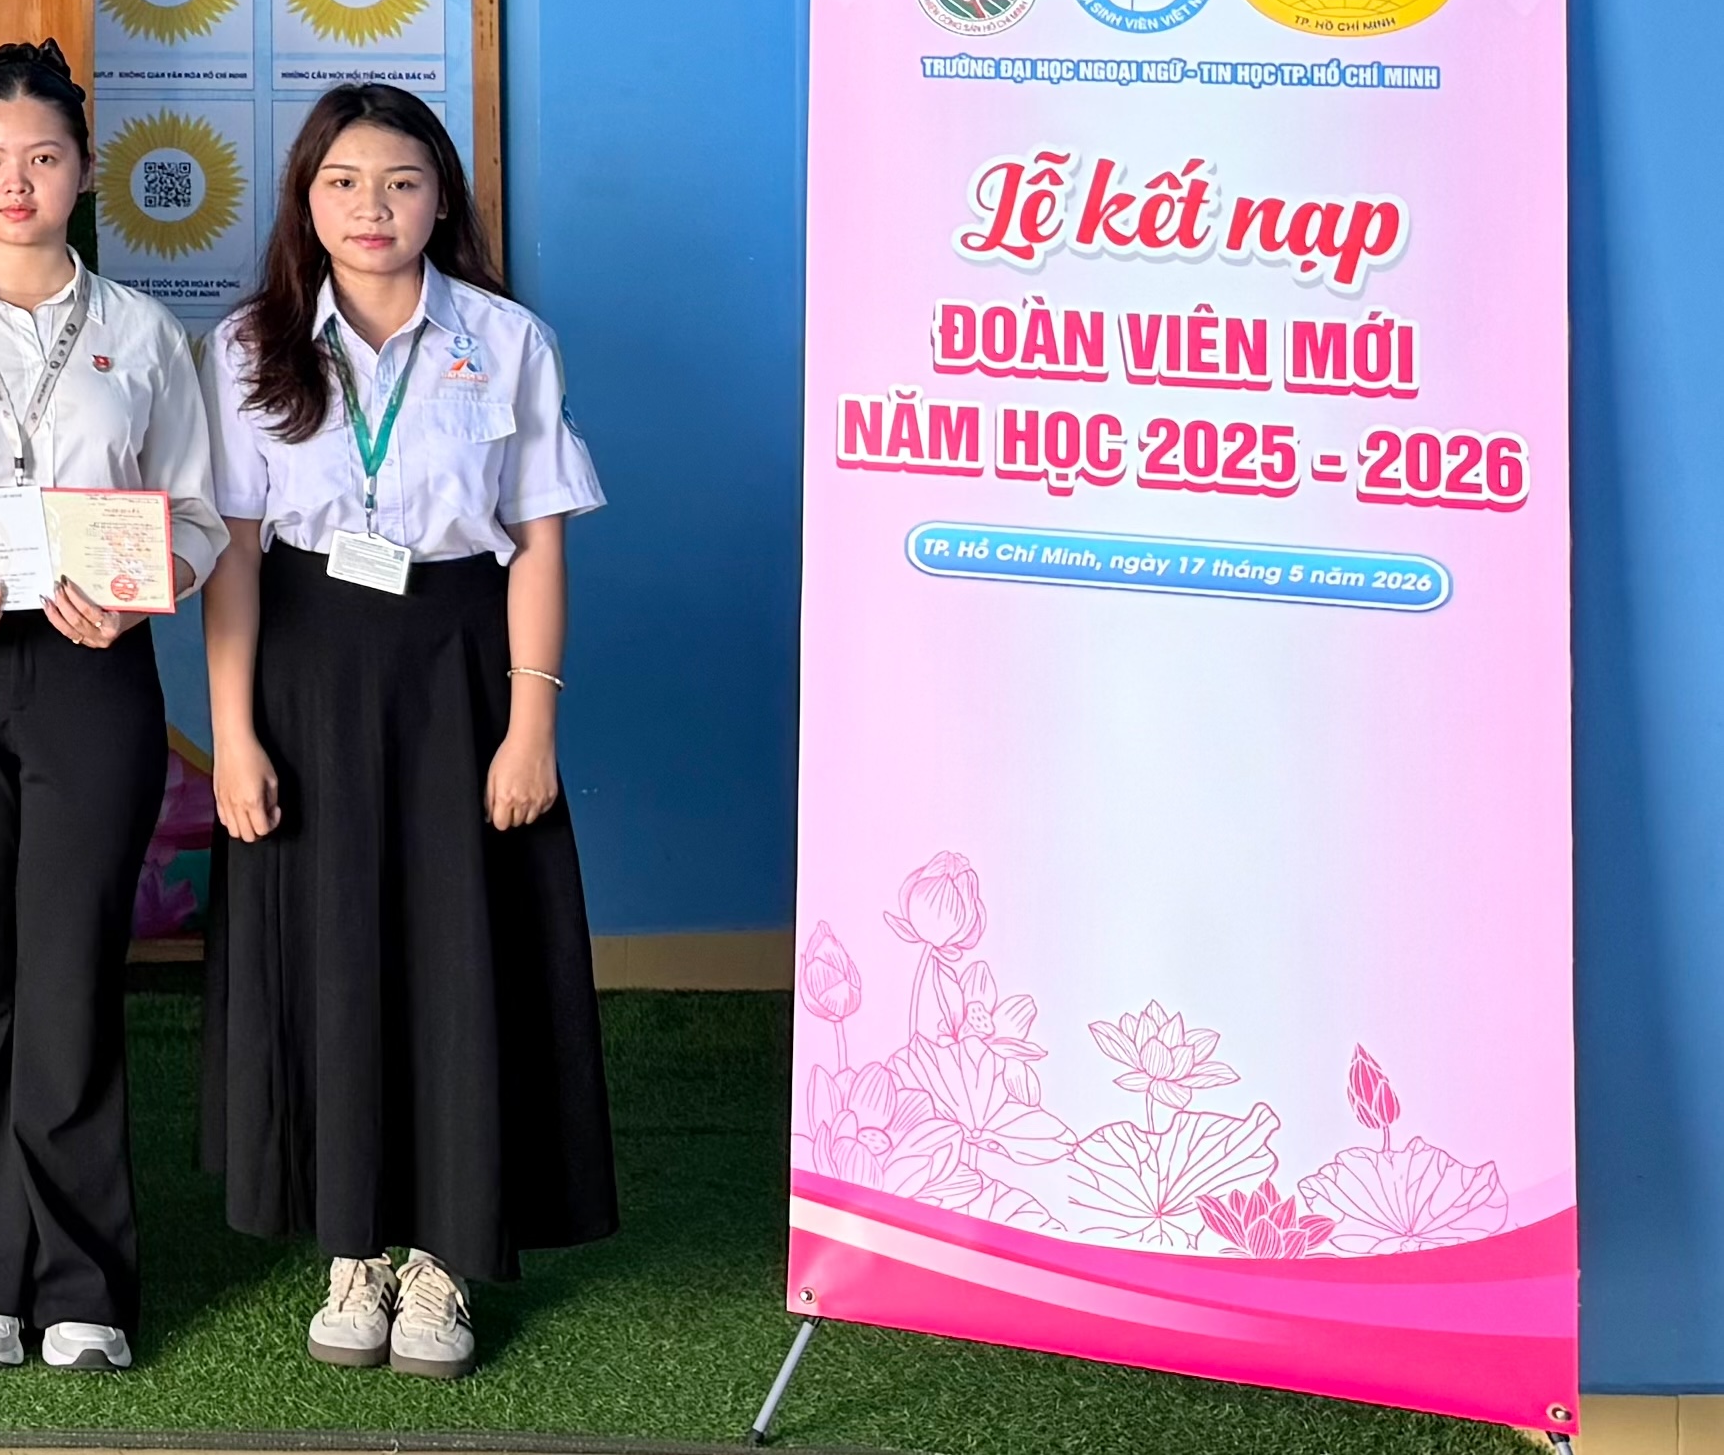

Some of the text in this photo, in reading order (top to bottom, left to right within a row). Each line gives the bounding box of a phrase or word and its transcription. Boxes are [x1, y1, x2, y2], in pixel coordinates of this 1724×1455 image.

[1090, 3, 1123, 27] SINH
[1124, 15, 1158, 30] VIÊN
[922, 53, 995, 79] TRƯỜNG
[1000, 58, 1032, 83] ĐẠI
[1036, 60, 1074, 84] HỌC
[1079, 61, 1138, 85] NGOẠI
[1142, 58, 1186, 82] NGỮ
[1200, 63, 1231, 83] TIN
[1236, 65, 1276, 90] HỌC
[1281, 65, 1308, 85] TP.
[1345, 61, 1378, 87] CHÍ
[1384, 67, 1439, 89] MINH
[960, 151, 1400, 284] Lễ kết nạp
[938, 295, 1415, 386] ĐOÀN VIÊN MỚI
[842, 388, 982, 465] NĂM
[1002, 411, 1127, 490] HỌC
[1139, 419, 1297, 484] 2025
[1363, 430, 1525, 501] 2026
[923, 538, 950, 557] TP.
[996, 543, 1037, 564] Chí
[1041, 547, 1103, 571] Minh,
[1110, 551, 1168, 577] ngày
[1178, 556, 1203, 575] 17
[1212, 558, 1282, 585] tháng
[1289, 564, 1304, 582] 5
[1311, 564, 1365, 587] năm
[1372, 570, 1433, 593] 2026
